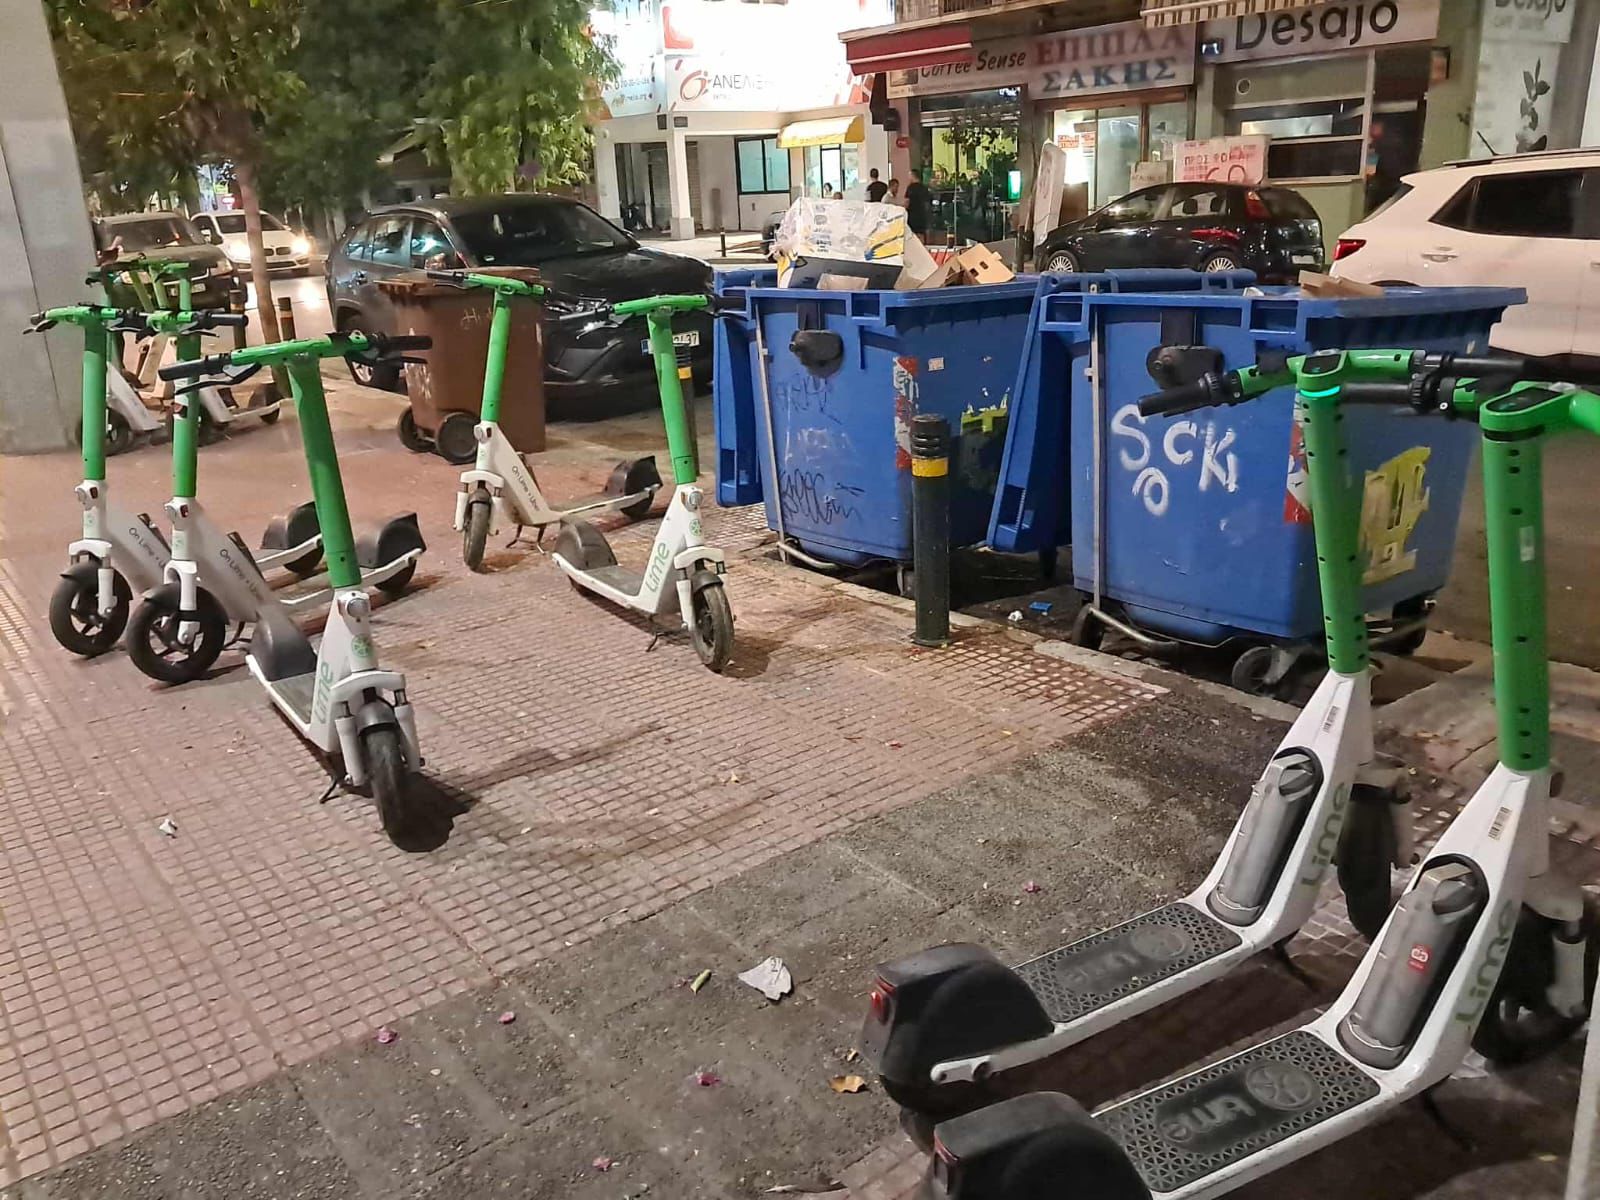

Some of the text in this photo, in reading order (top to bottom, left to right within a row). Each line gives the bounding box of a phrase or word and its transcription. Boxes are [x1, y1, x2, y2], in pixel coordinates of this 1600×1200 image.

[1037, 27, 1186, 65] ΕΠΙΠΛΑ
[1235, 0, 1398, 50] Desajo
[1042, 56, 1177, 92] ΣΑΚΗΣ
[646, 542, 669, 593] Lime
[1301, 781, 1349, 888] Lime
[1455, 904, 1512, 1023] Lime
